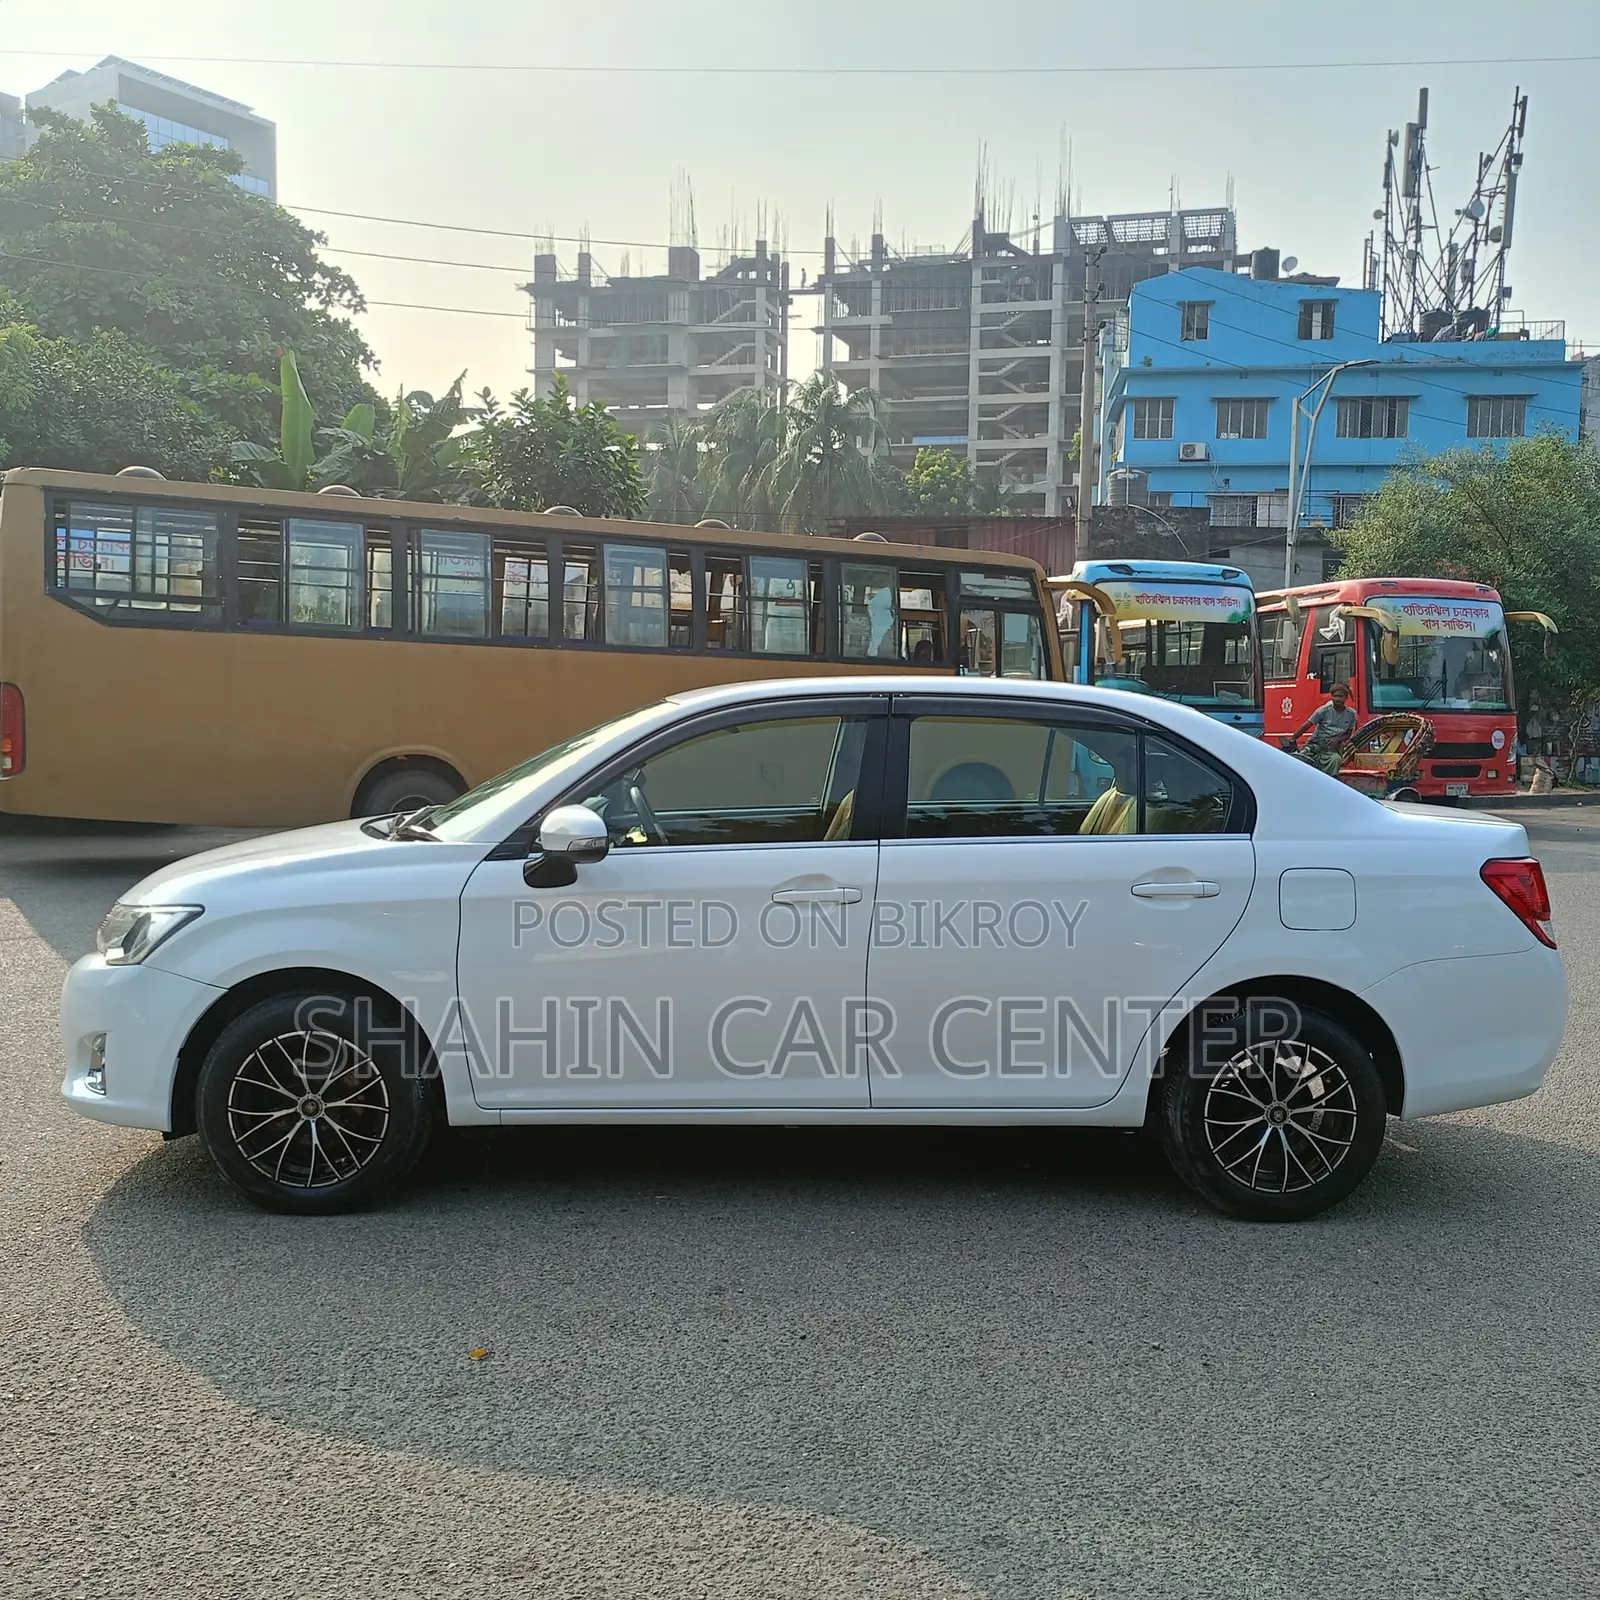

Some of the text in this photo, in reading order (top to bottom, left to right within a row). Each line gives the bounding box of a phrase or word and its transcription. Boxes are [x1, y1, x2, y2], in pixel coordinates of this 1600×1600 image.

[1134, 592, 1171, 605] হাতিরঝিল
[1172, 595, 1201, 606] চক্রাকার
[1202, 596, 1216, 607] বাস
[1401, 603, 1450, 617] হাতিরঝিল
[1452, 607, 1490, 619] চক্রাকার
[1421, 619, 1440, 630] বাস
